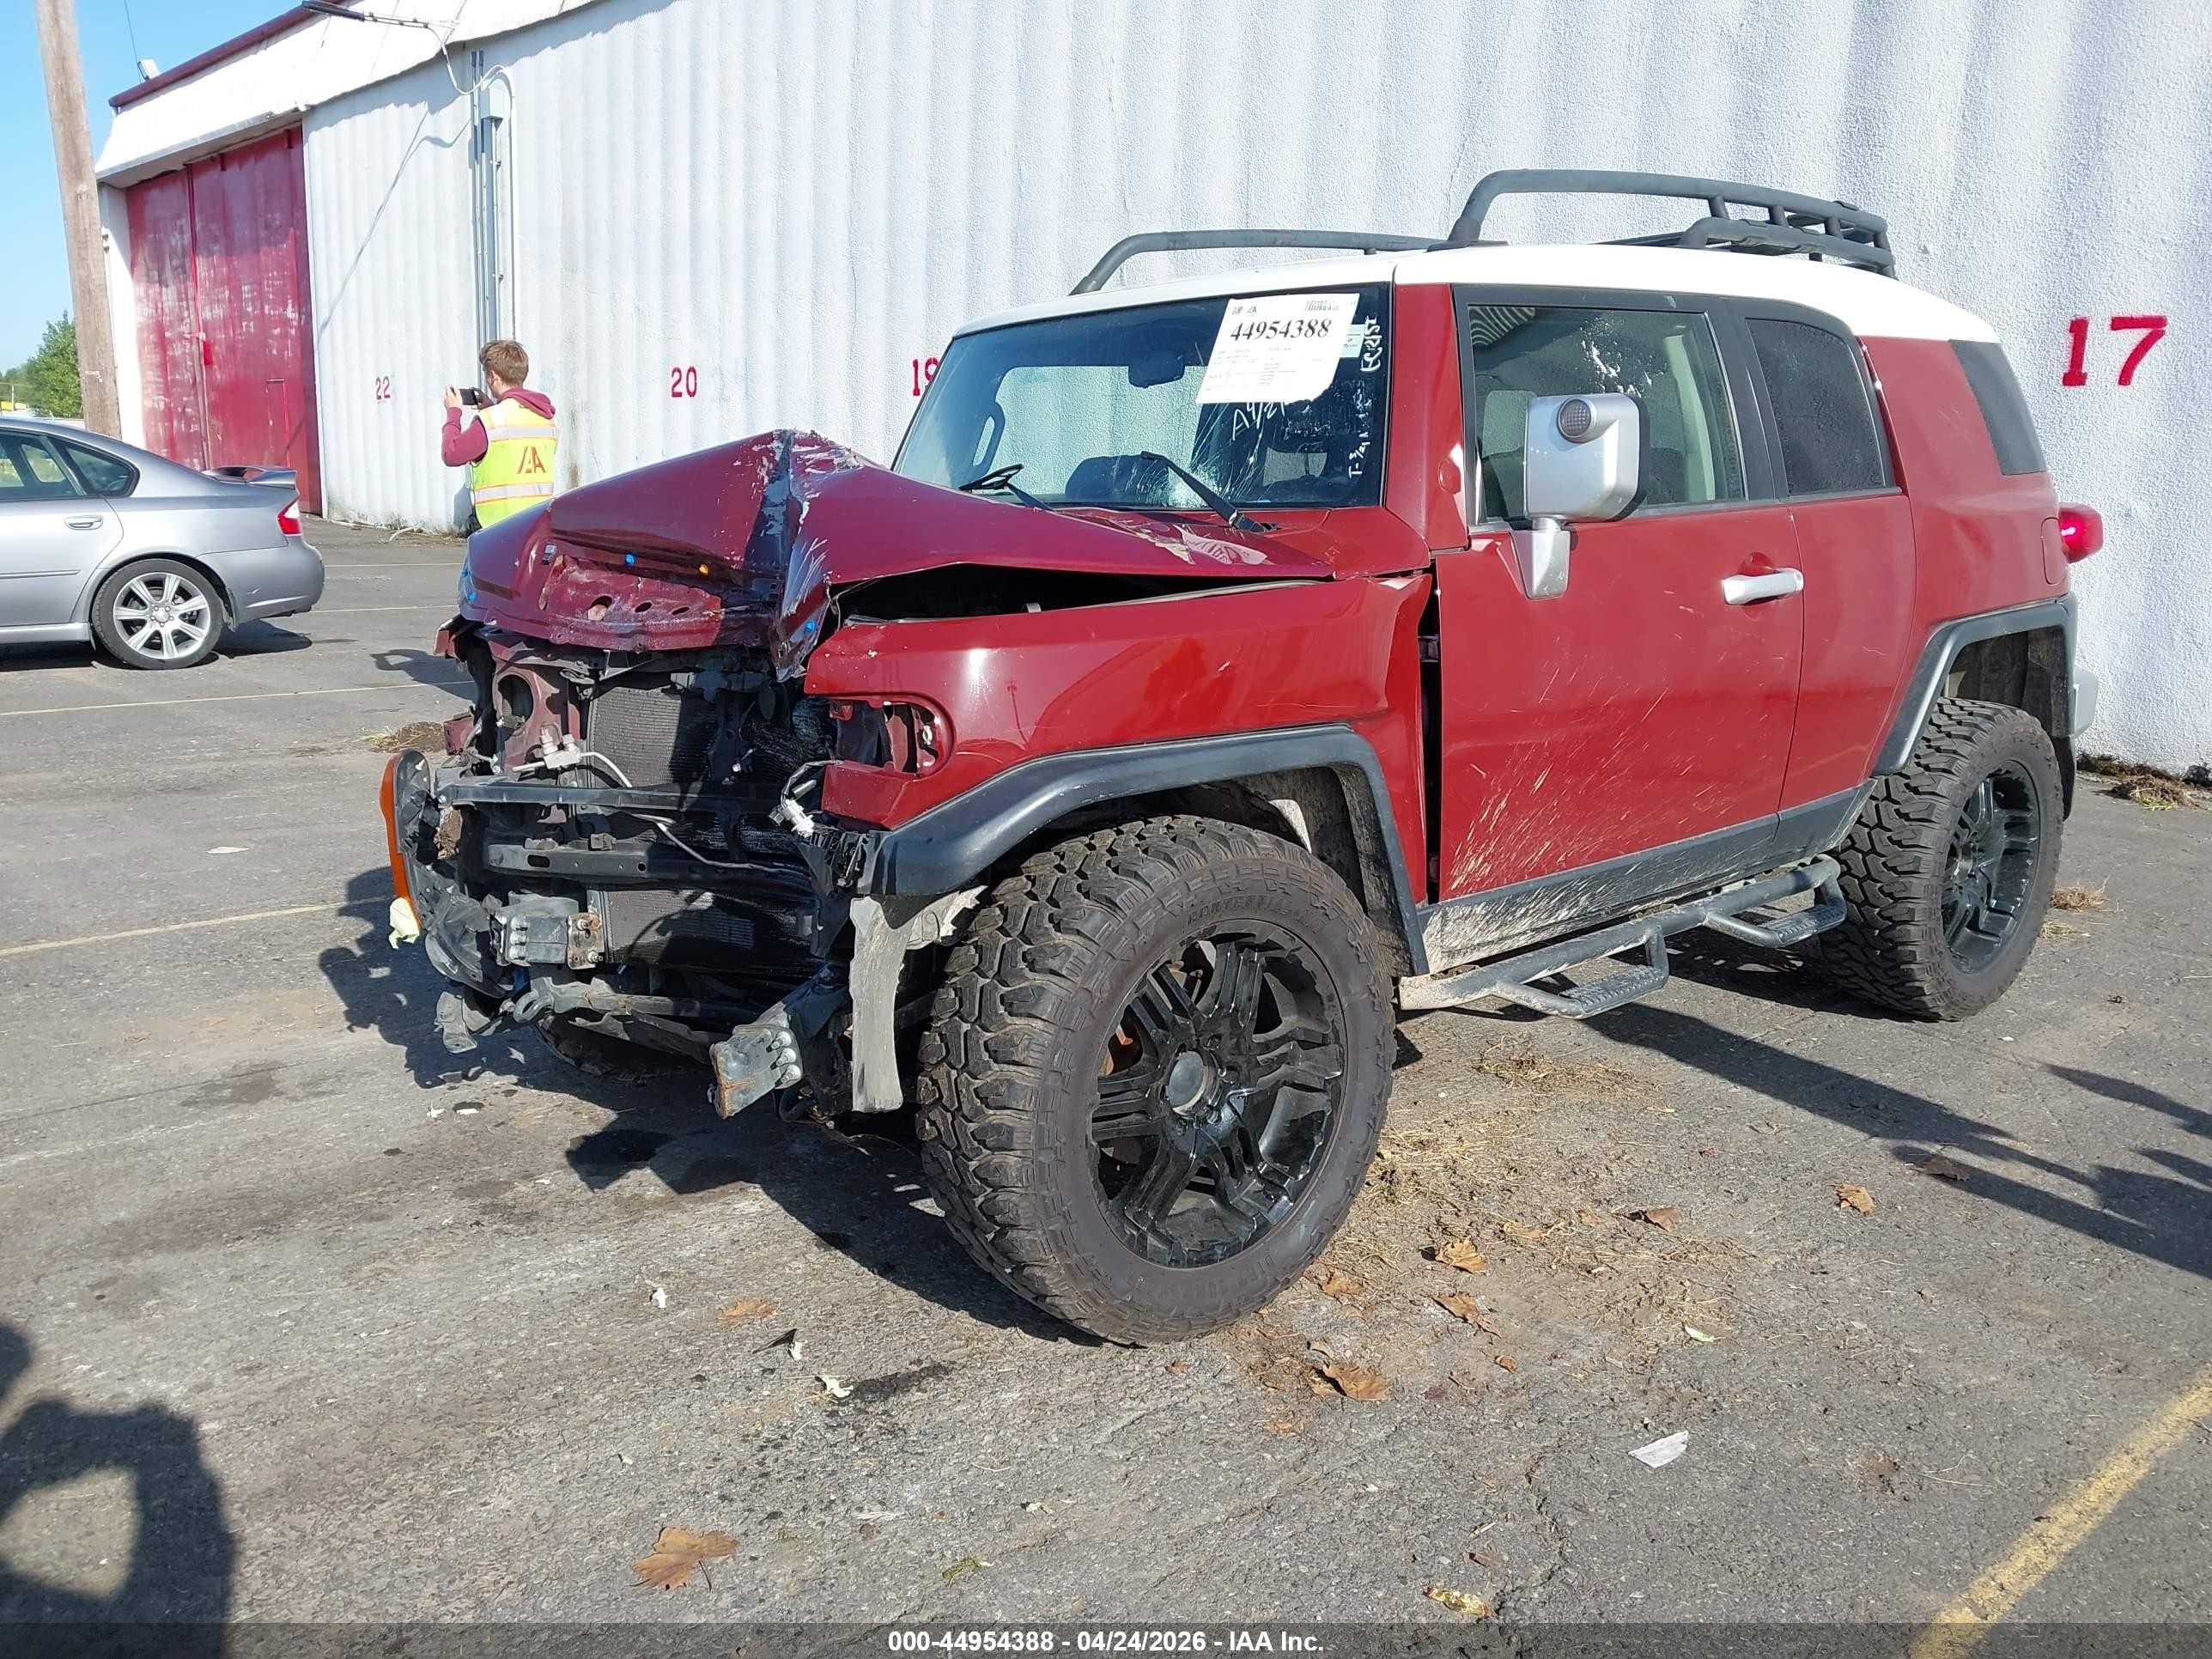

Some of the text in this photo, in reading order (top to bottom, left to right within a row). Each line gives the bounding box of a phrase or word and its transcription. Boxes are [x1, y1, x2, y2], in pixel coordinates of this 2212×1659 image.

[1231, 318, 1333, 341] 44954388
[2063, 315, 2168, 386] 17
[375, 375, 391, 400] 22
[671, 366, 697, 398] 20
